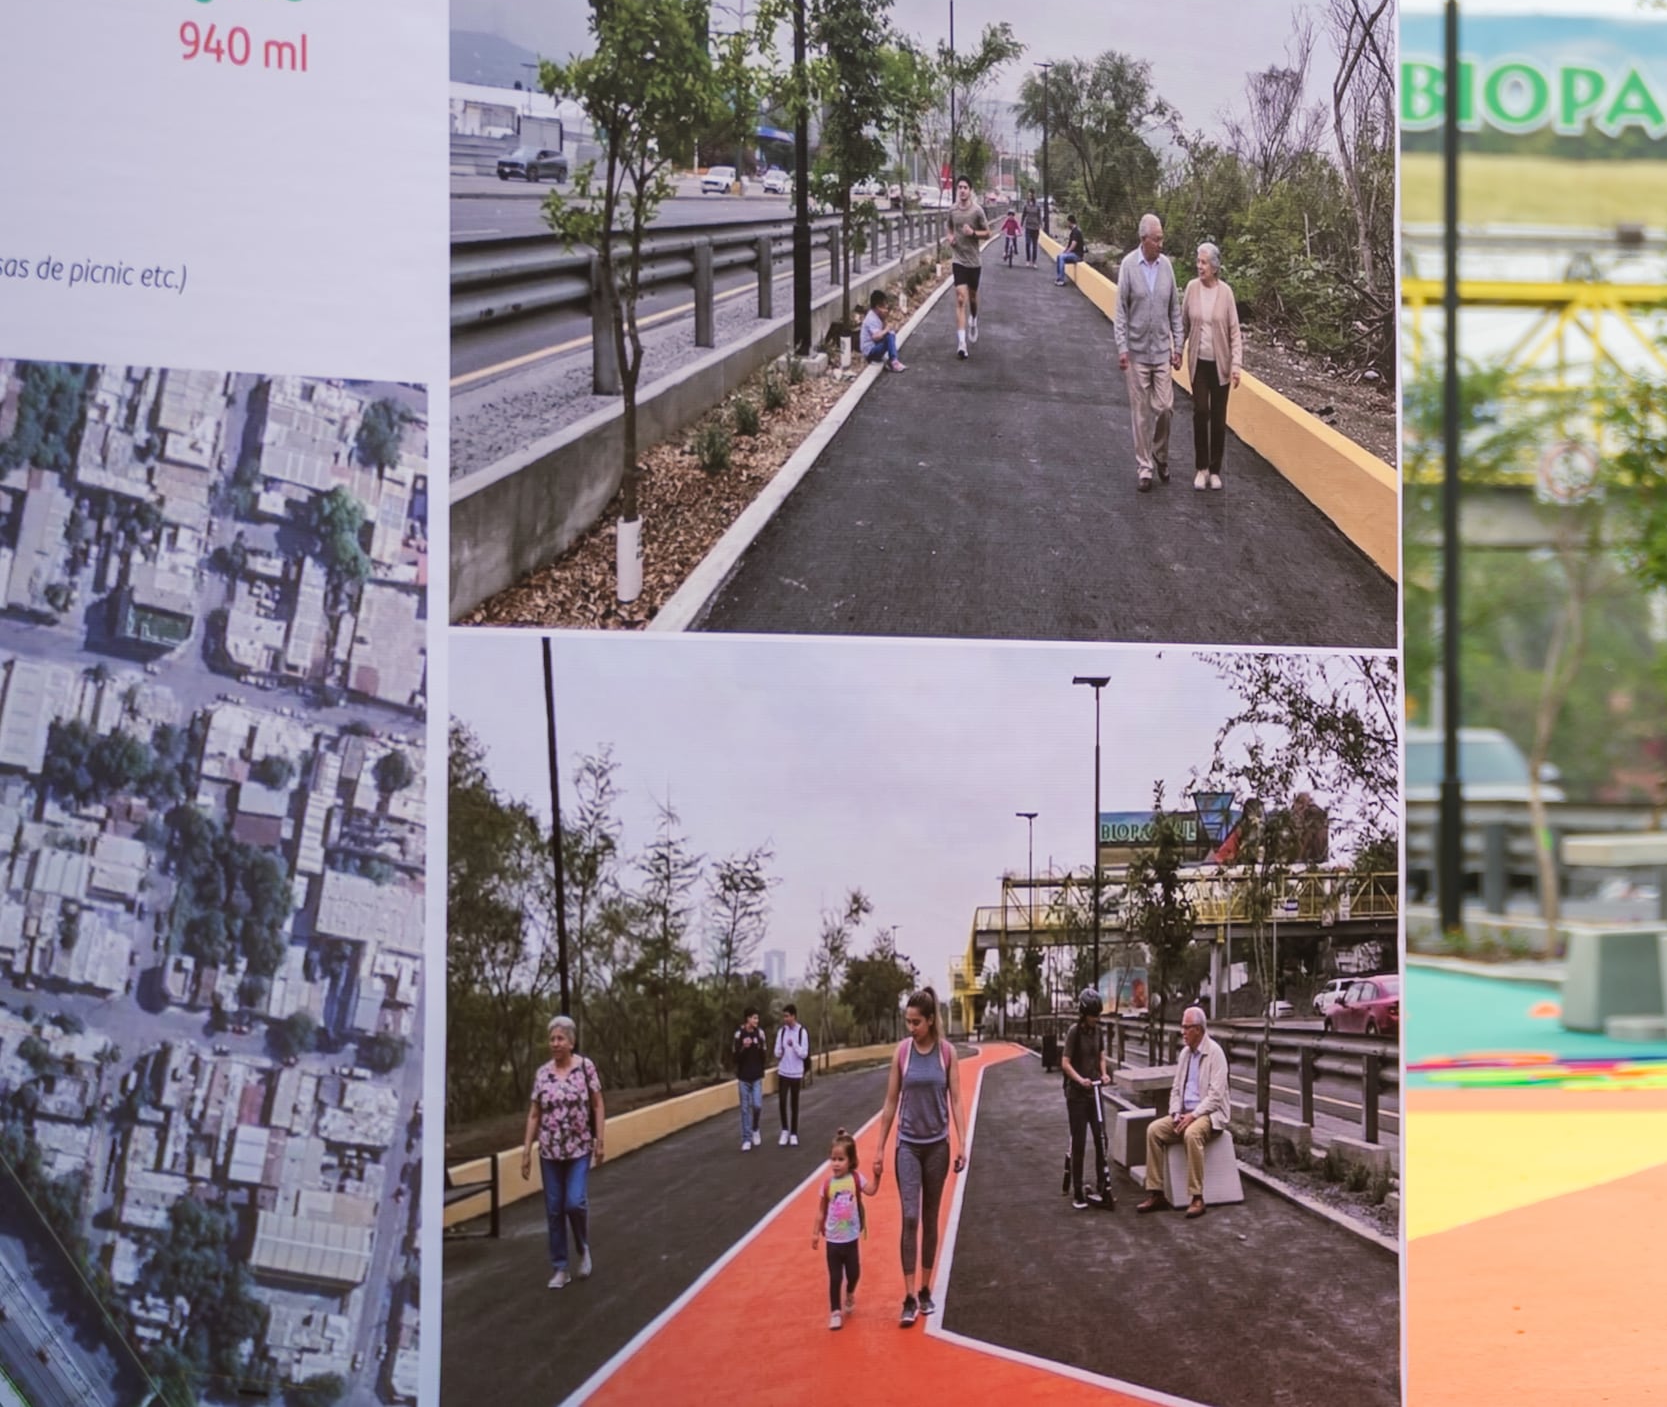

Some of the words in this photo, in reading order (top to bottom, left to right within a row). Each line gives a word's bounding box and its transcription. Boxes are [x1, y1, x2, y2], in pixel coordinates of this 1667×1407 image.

[179, 20, 251, 66] 940
[263, 34, 307, 72] ml
[36, 255, 64, 281] de
[69, 258, 135, 288] picnic
[141, 264, 187, 295] etc.)
